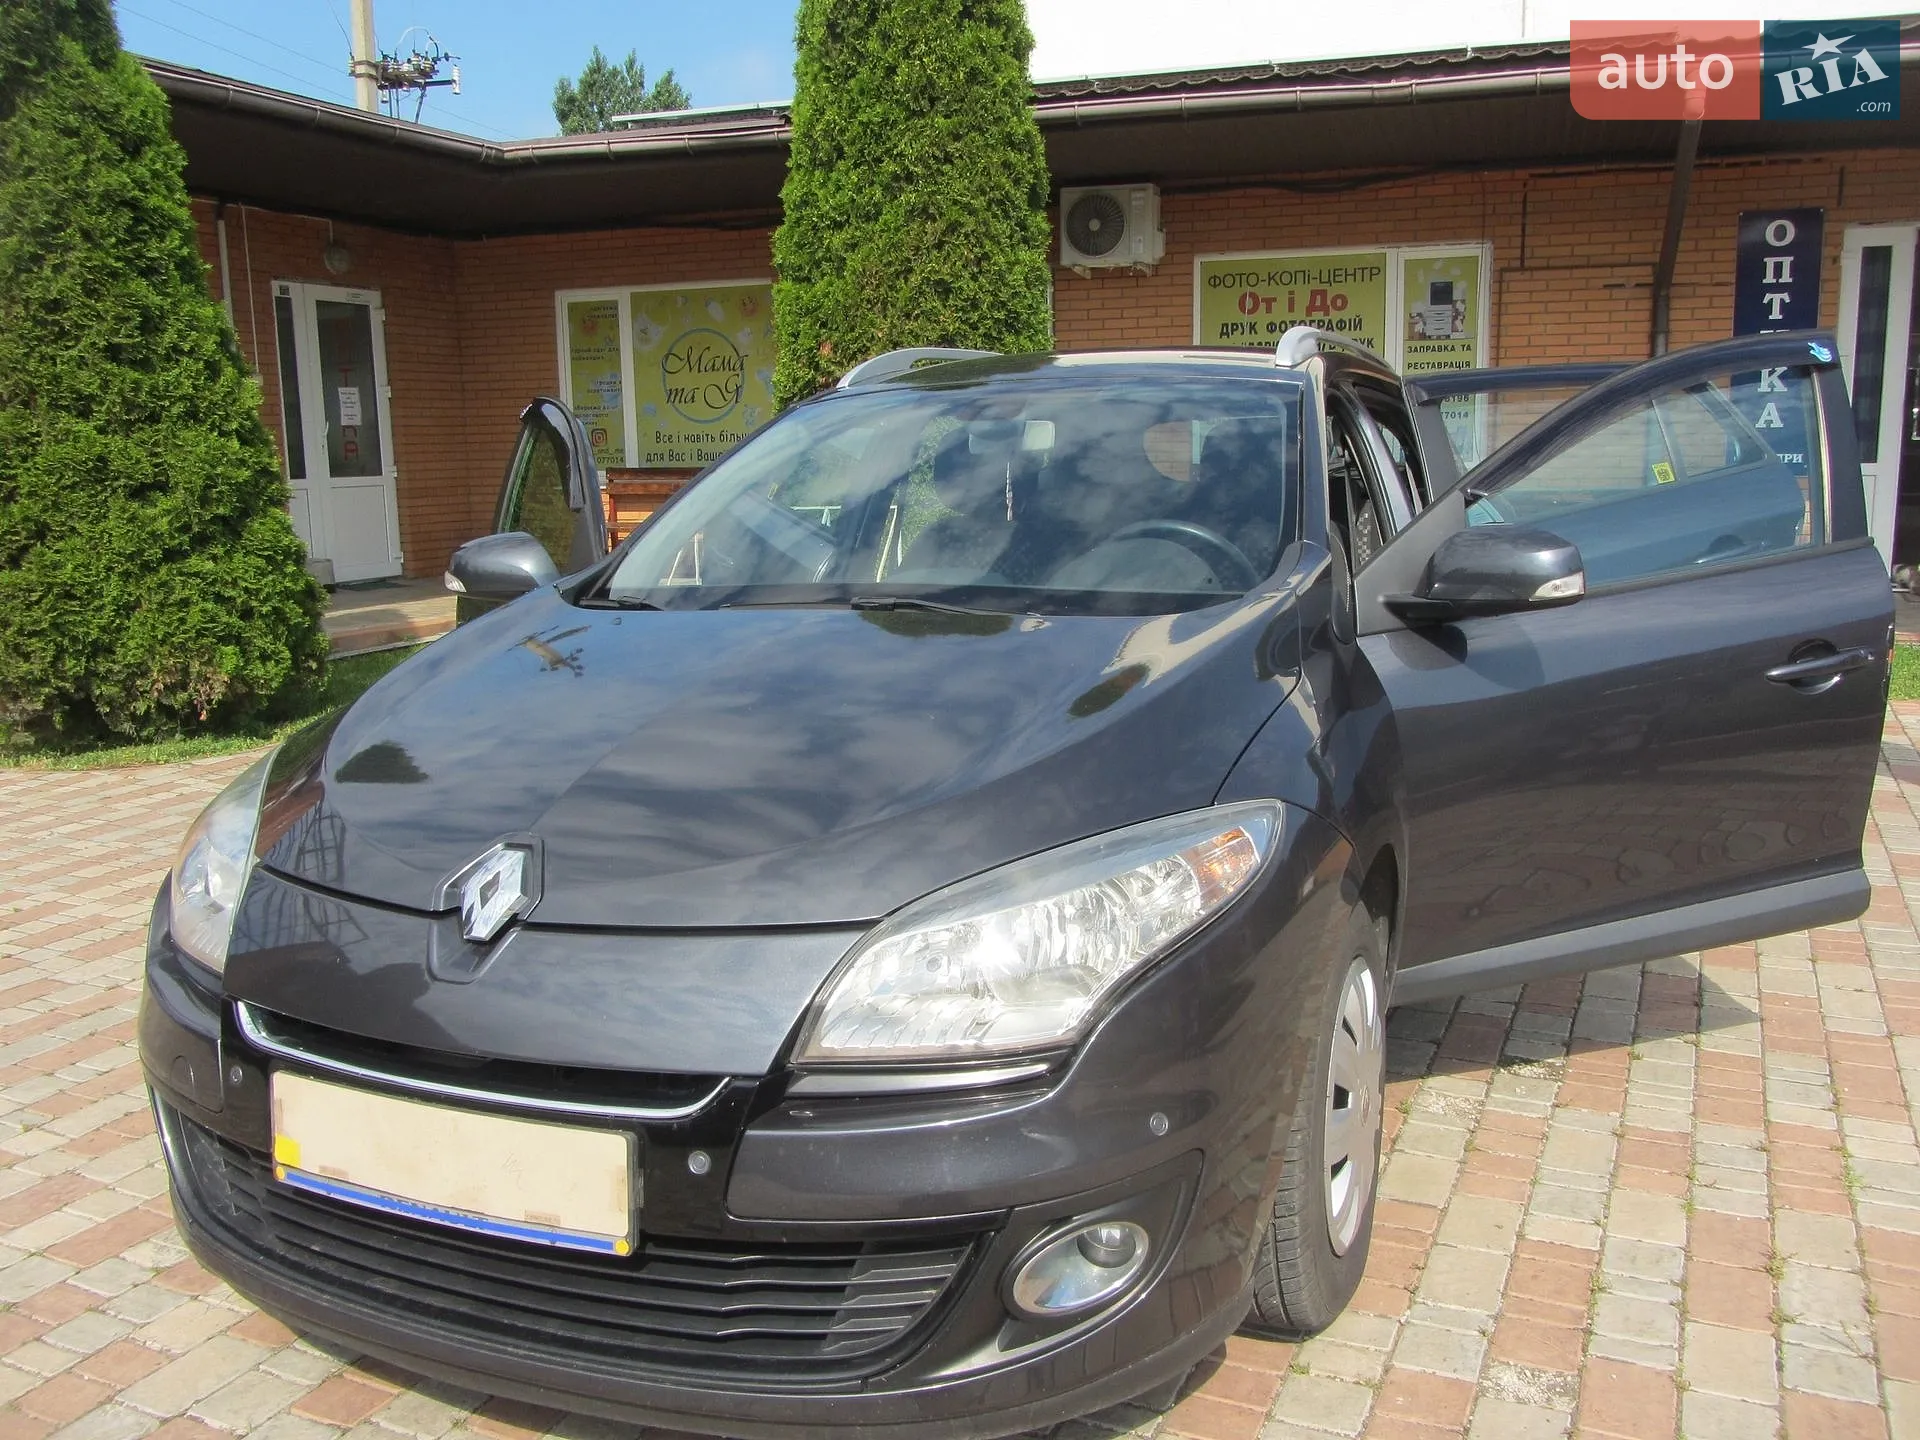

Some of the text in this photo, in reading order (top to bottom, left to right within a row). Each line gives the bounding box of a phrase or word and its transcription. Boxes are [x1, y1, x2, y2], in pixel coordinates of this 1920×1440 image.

[1238, 288, 1349, 318] От і До
[1219, 321, 1258, 339] ДРУК
[1755, 219, 1796, 429] ОПТКА
[1407, 343, 1472, 354] ЗАПРАВКА ТА
[661, 346, 749, 375] Мама
[1407, 360, 1471, 371] РЕСТАВРАЦІЯ
[655, 431, 673, 443] Все
[677, 430, 681, 442] і
[684, 429, 715, 443] навіть
[646, 453, 664, 463] для
[668, 449, 685, 462] Вас
[689, 451, 693, 462] і
